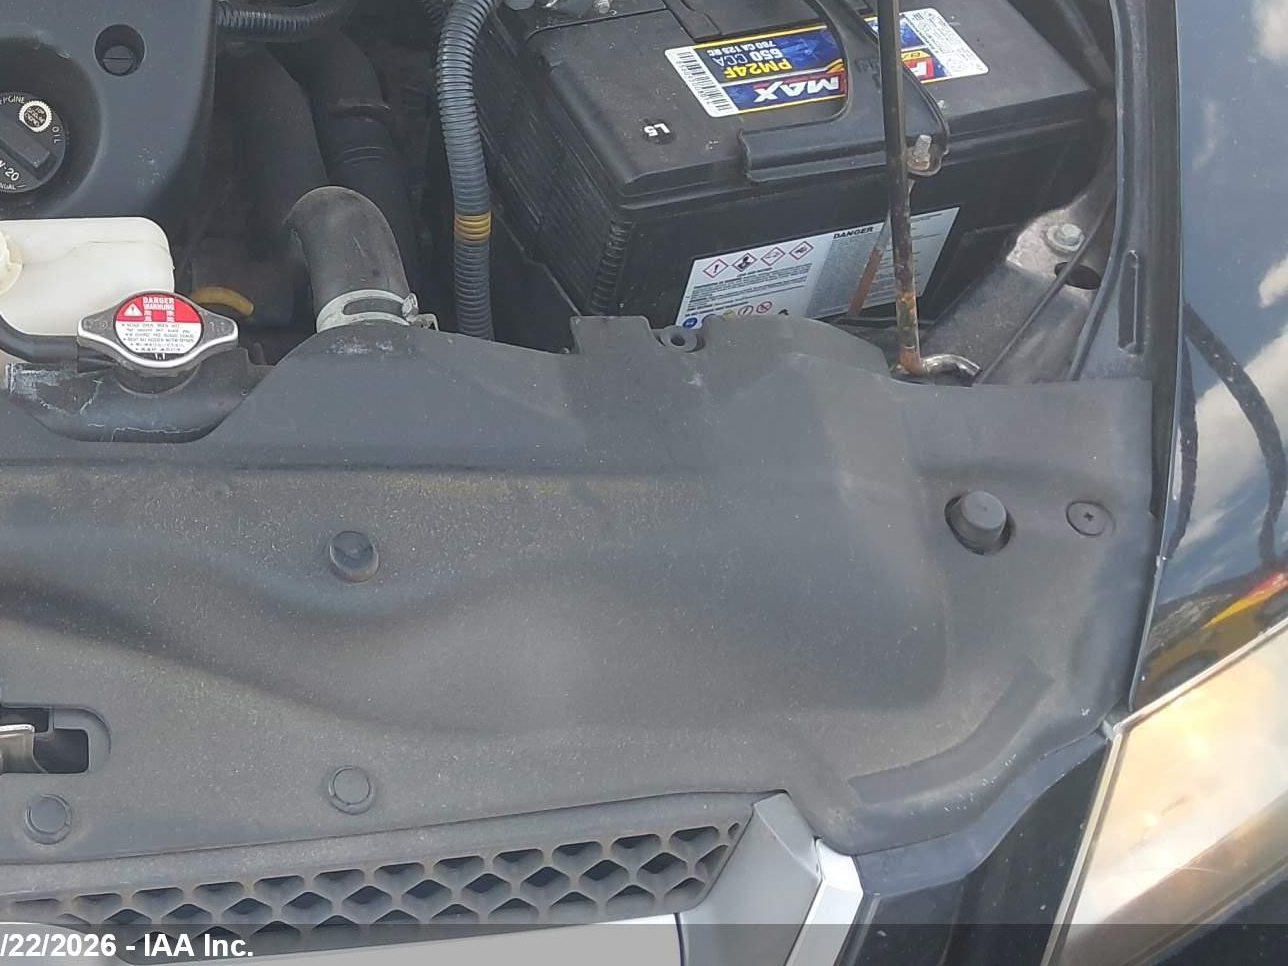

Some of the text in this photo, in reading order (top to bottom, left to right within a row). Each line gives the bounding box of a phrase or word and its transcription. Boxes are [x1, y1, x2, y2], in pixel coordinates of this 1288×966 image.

[740, 43, 754, 51] CA
[713, 48, 783, 67] 650 CCA
[723, 58, 793, 79] PM24F
[753, 76, 839, 103] MAX
[52, 126, 62, 144] OIL
[833, 226, 874, 239] DANGER
